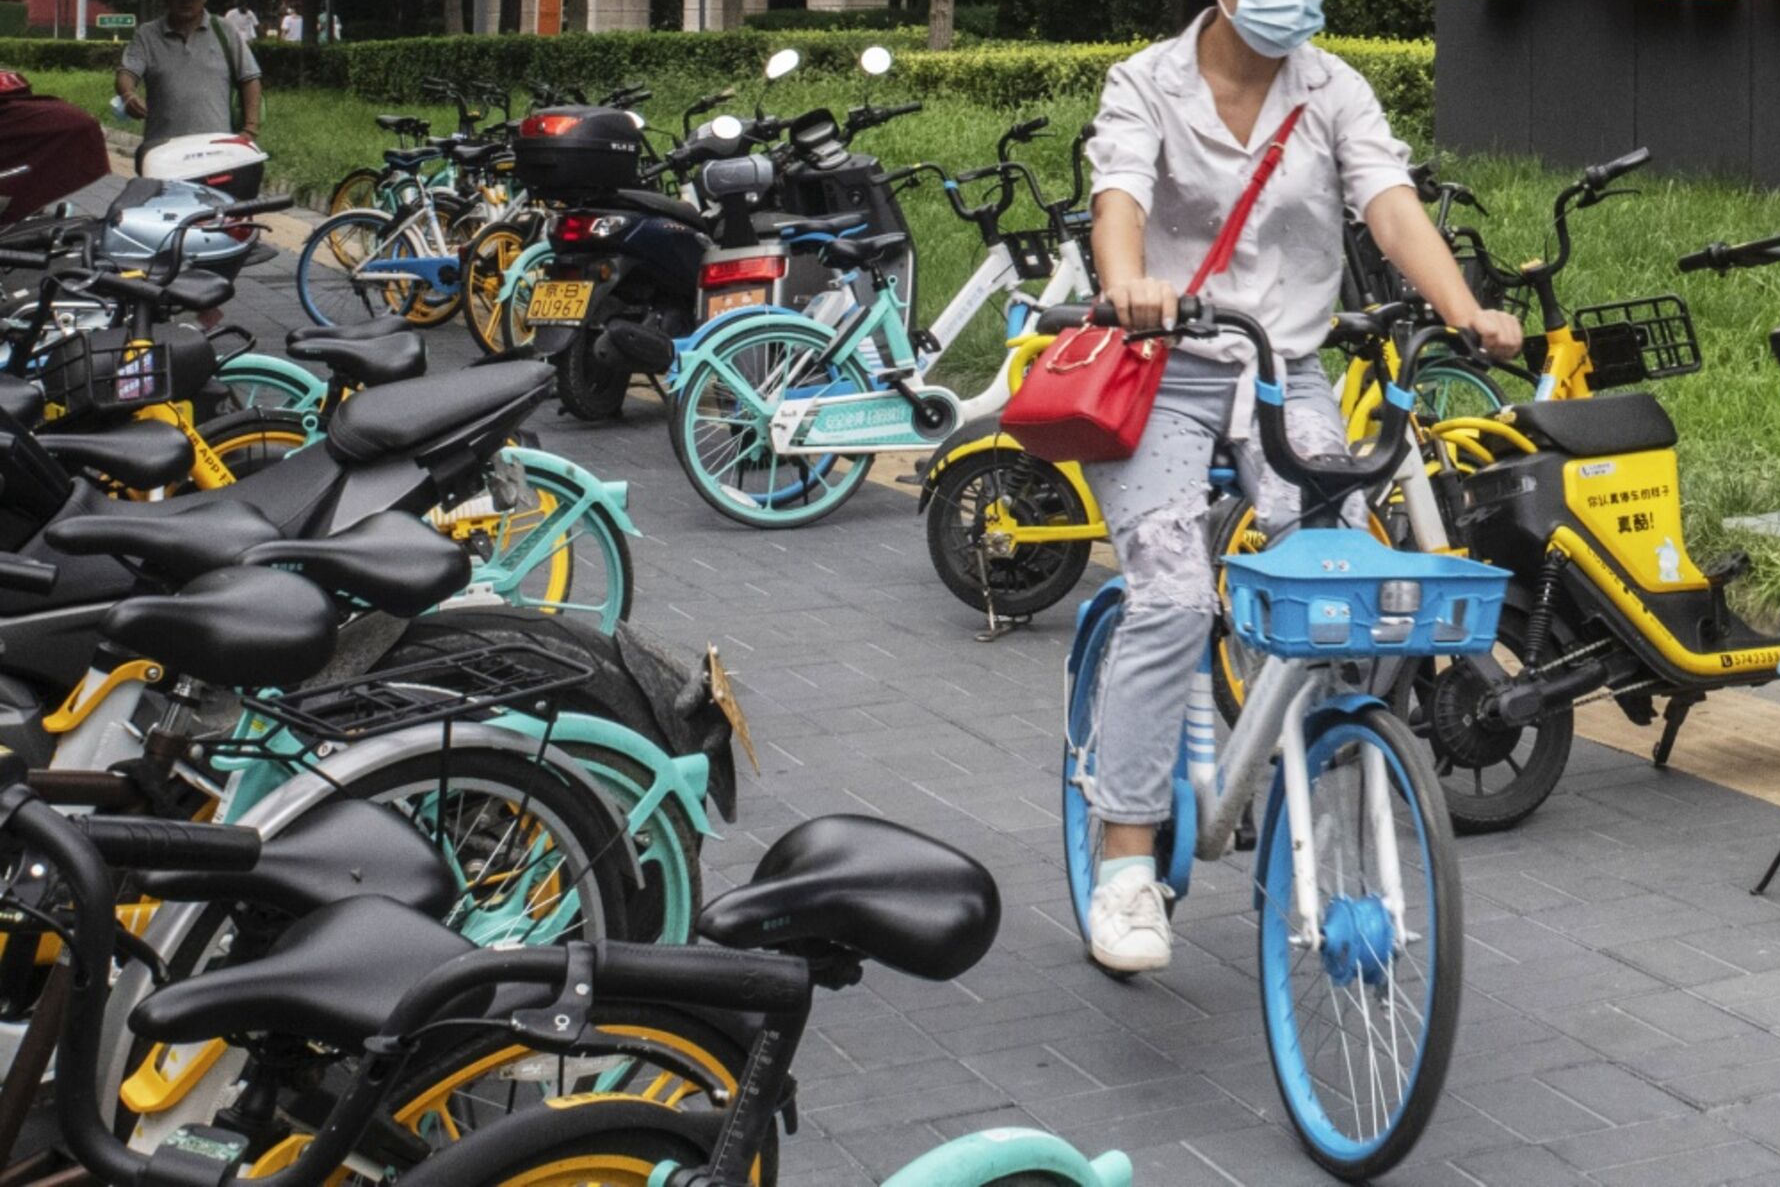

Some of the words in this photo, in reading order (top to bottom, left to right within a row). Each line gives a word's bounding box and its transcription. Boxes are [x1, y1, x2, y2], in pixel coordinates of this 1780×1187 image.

[529, 299, 584, 317] QU967
[1587, 485, 1669, 508] 你认真停车的样子
